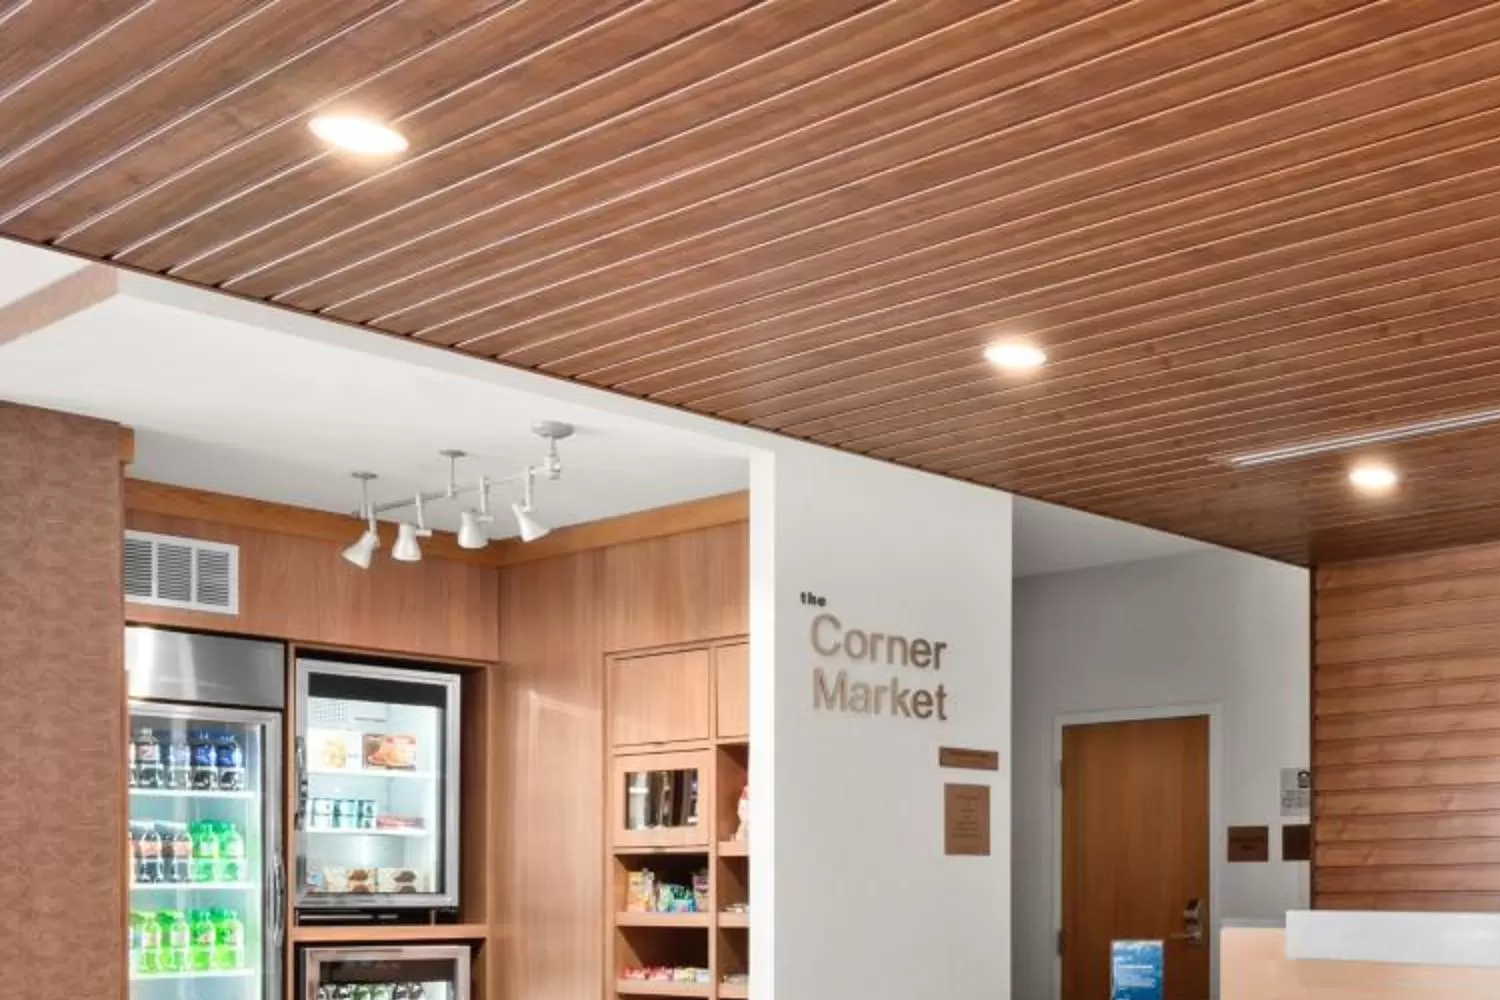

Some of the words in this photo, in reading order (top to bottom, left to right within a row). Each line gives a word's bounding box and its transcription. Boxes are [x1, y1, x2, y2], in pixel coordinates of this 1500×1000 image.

[800, 592, 826, 607] the
[811, 613, 948, 669] Corner
[812, 667, 948, 720] Market
